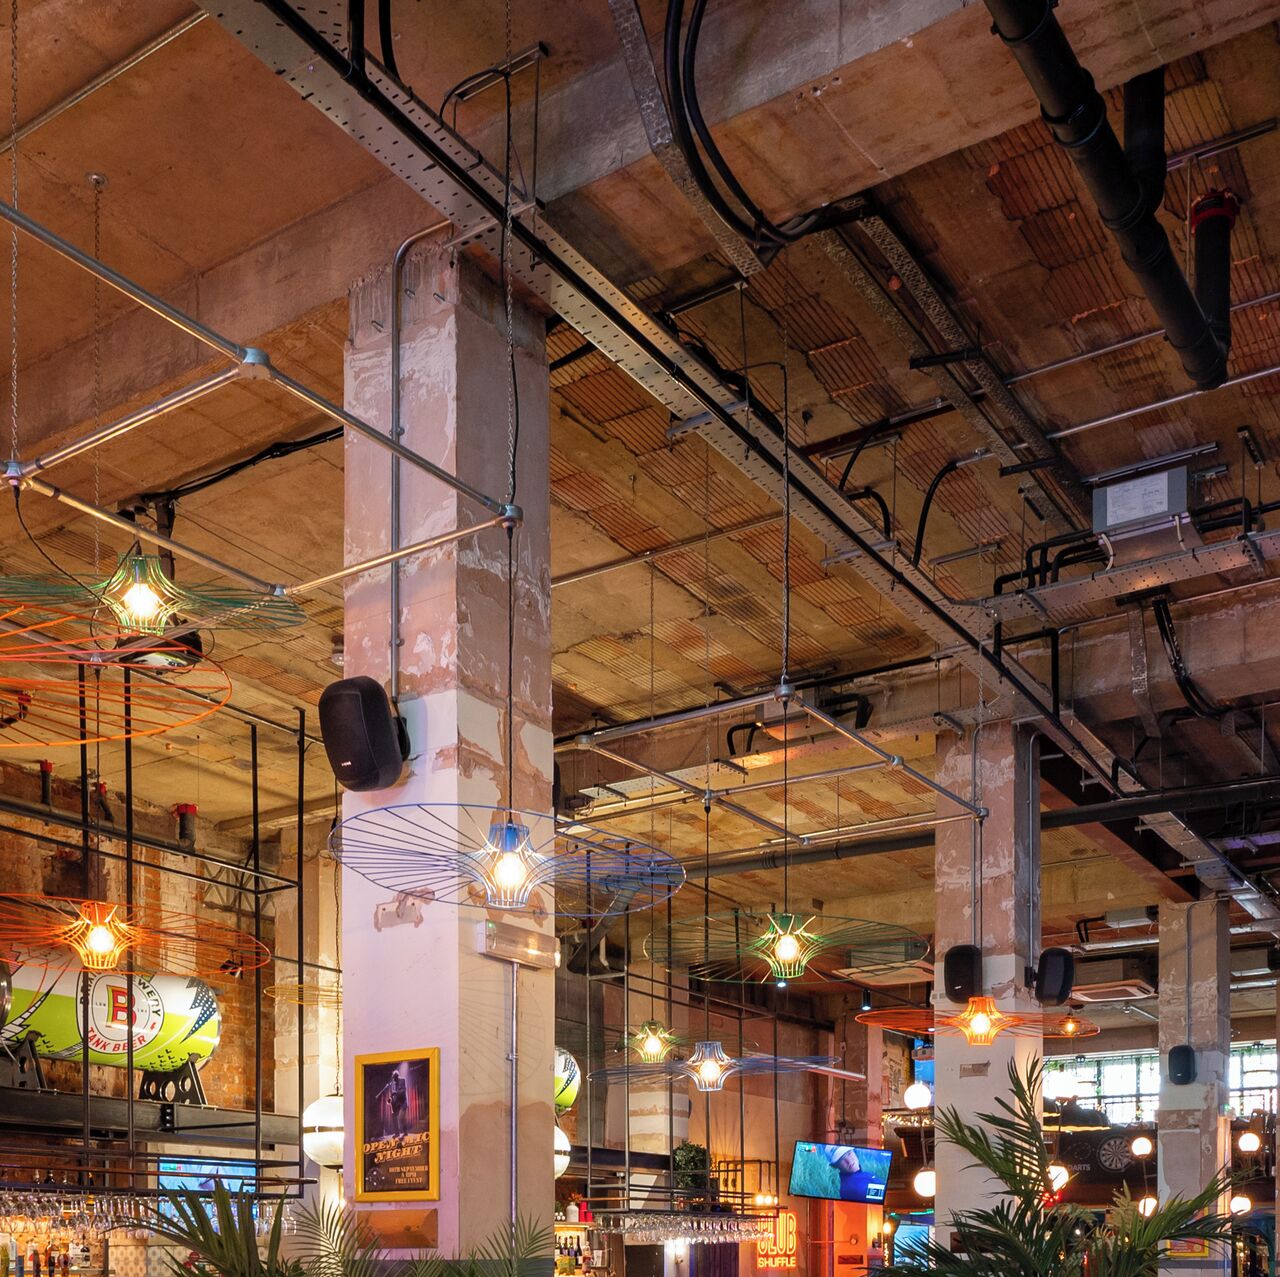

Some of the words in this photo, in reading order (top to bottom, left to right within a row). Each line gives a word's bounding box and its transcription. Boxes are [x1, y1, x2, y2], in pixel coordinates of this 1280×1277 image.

[88, 1027, 110, 1051] TANK
[112, 1034, 147, 1052] BEER
[363, 1137, 400, 1154] OPEN
[402, 1131, 430, 1147] MIC
[374, 1144, 423, 1163] NIGHT
[757, 1212, 797, 1255] CLUB
[758, 1256, 797, 1268] SHUFFLE
